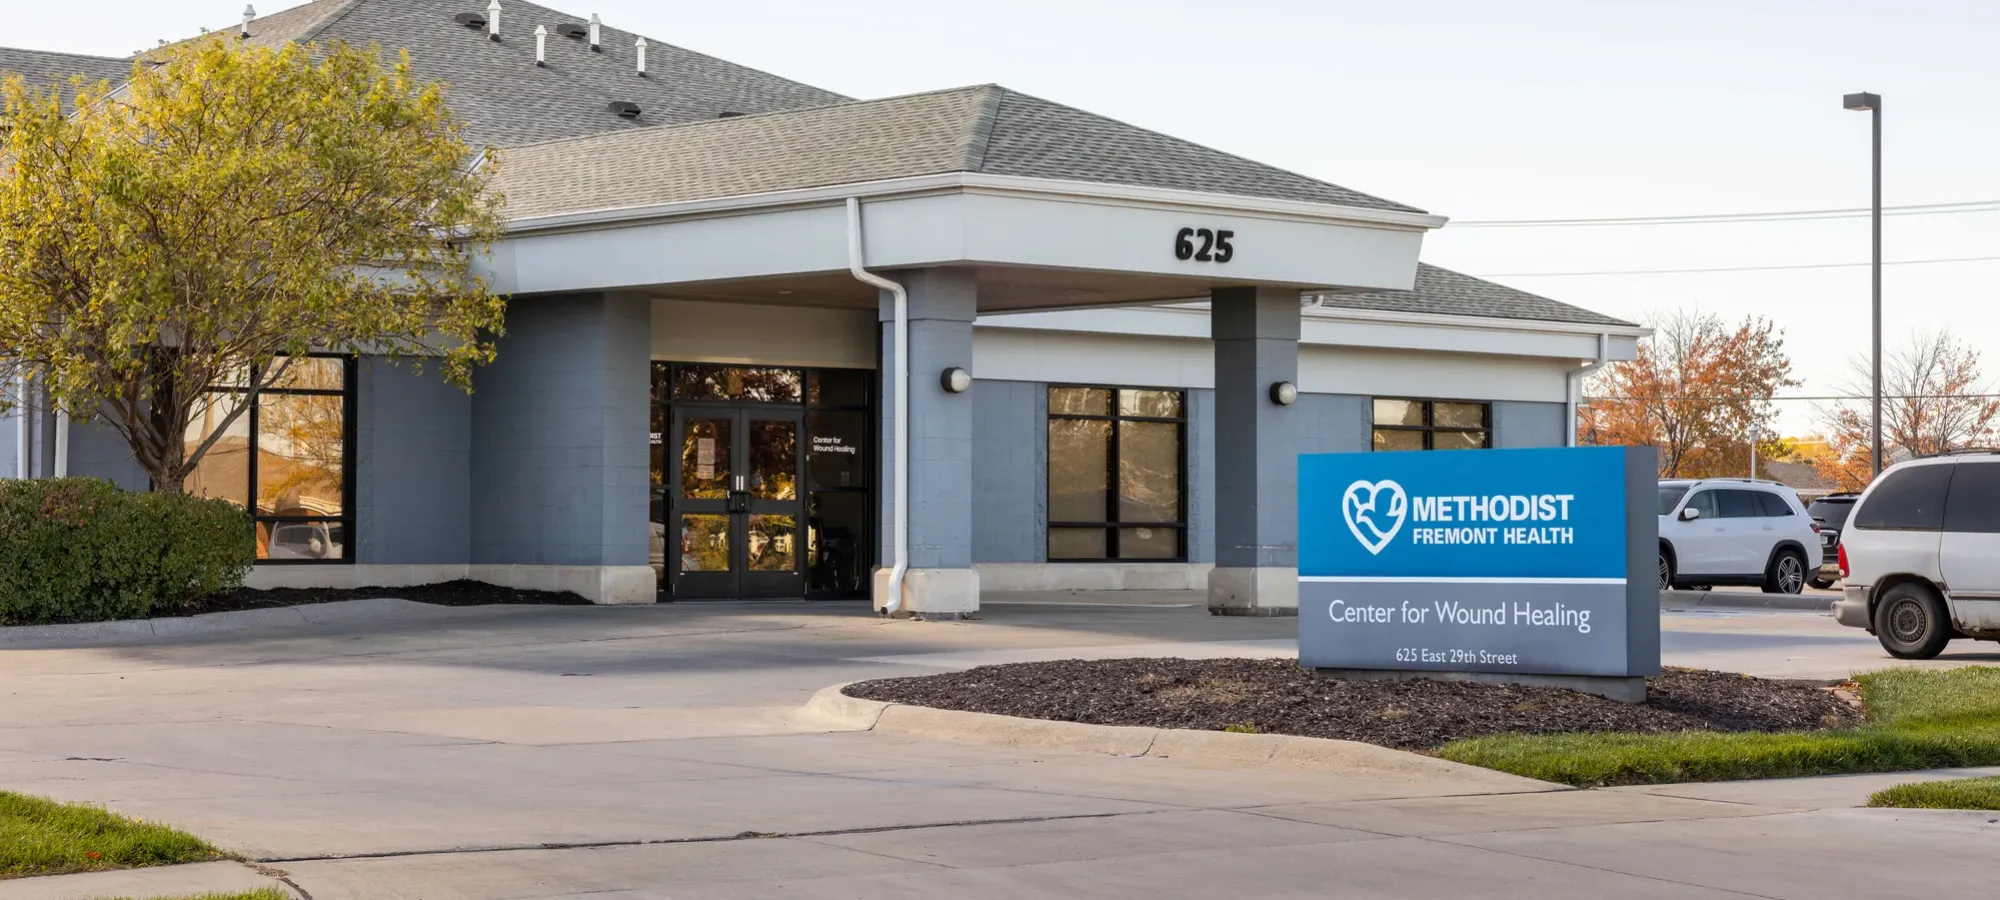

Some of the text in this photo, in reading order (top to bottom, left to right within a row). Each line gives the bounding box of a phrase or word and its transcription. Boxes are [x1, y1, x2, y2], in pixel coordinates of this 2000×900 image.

[1175, 227, 1234, 263] 625
[834, 446, 856, 455] Healing
[1413, 494, 1574, 521] METHODIST
[1413, 527, 1574, 545] FREMONT HEALTH
[1329, 599, 1591, 634] Center for Wound Healing
[1396, 648, 1518, 665] 625 East 29th Street
